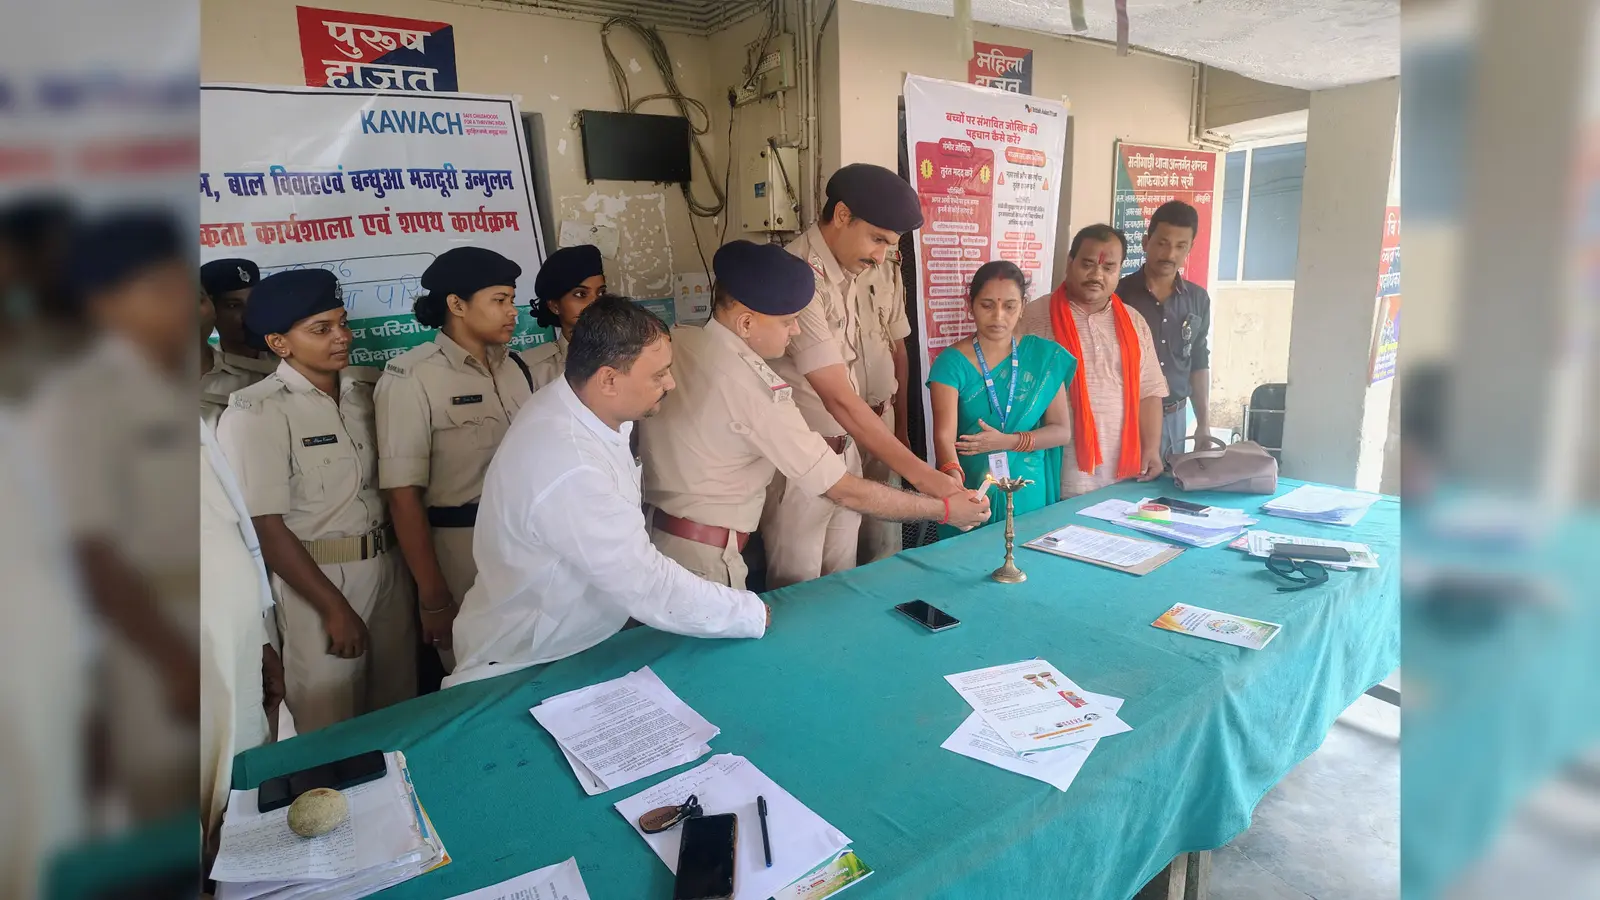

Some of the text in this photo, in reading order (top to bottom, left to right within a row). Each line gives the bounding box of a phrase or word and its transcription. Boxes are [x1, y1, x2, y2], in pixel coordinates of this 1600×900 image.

[976, 49, 1024, 75] महिला
[321, 59, 438, 91] हाजत
[361, 110, 463, 135] KAWACH
[946, 112, 1038, 134] बच्चों पर संभावित जोखिम की
[966, 129, 1022, 145] पहचान कैसे करें?
[1155, 157, 1169, 169] थाना
[224, 172, 268, 197] बाल
[348, 167, 405, 199] बन्धुआ
[406, 163, 461, 198] मजदूरी
[462, 168, 514, 199] उन्मुलन
[1169, 172, 1179, 187] की
[1180, 172, 1194, 189] सूची
[251, 213, 355, 245] कार्यशाला
[358, 207, 392, 235] एवं
[394, 210, 445, 233] शपथ
[448, 205, 520, 232] कार्यक्रम
